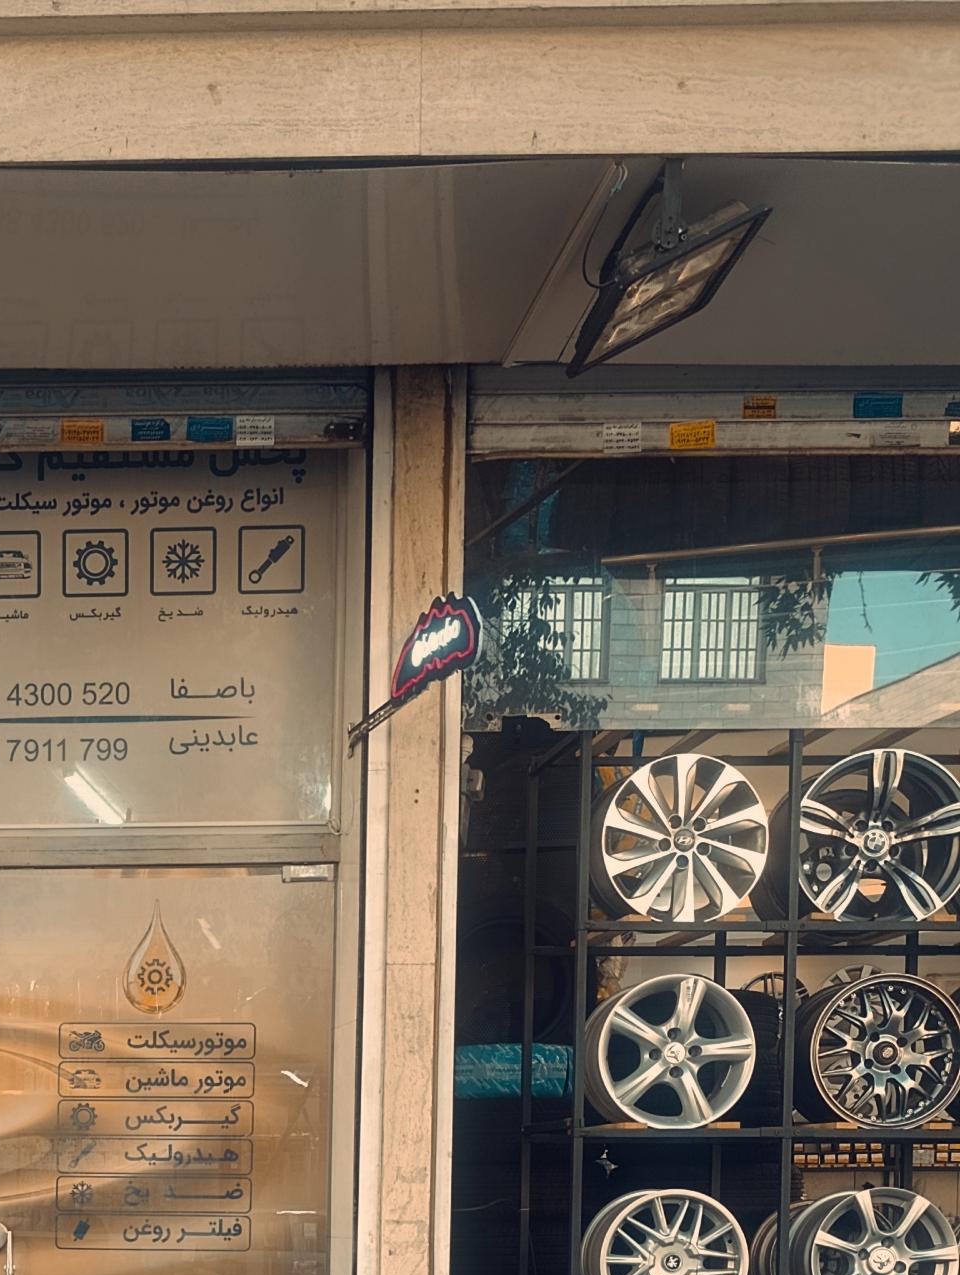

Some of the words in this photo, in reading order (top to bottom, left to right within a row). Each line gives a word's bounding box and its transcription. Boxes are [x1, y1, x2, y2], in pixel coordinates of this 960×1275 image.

[62, 496, 113, 516] موتور
[187, 493, 234, 513] روغن
[240, 488, 285, 509] انواع
[69, 606, 122, 621] گیربکس
[240, 605, 299, 618] هیدرولیک
[6, 683, 73, 707] 4300
[81, 682, 131, 705] 520
[6, 738, 68, 763] 7911
[80, 737, 128, 762] 799
[168, 725, 259, 755] عابدینی
[126, 1030, 247, 1057] موتورسیکلت
[125, 1068, 189, 1093] ماشین
[194, 1071, 247, 1094] موتور
[125, 1104, 242, 1130] گیربکس
[122, 1219, 171, 1243] روغن
[176, 1218, 243, 1242] فیلتر
